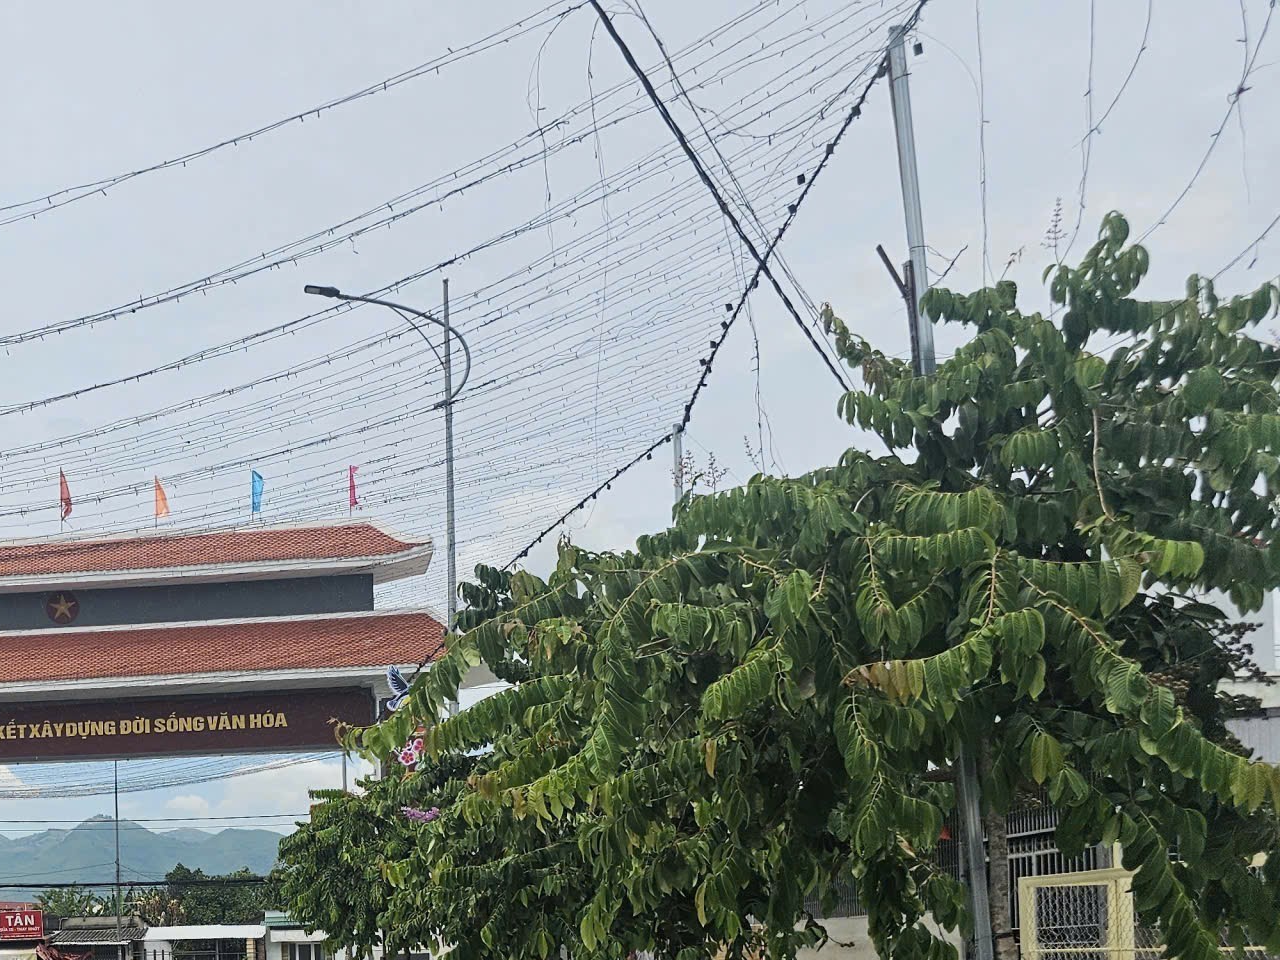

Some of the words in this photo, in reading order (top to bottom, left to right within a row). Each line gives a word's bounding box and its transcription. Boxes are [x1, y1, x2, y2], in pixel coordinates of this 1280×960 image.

[29, 720, 65, 738] XÂY
[65, 720, 116, 740] DỰNG
[119, 716, 150, 735] ĐỜI
[153, 712, 204, 733] SỐNG
[206, 712, 246, 731] VĂN
[249, 710, 288, 728] HÓA
[5, 913, 35, 926] TÂN
